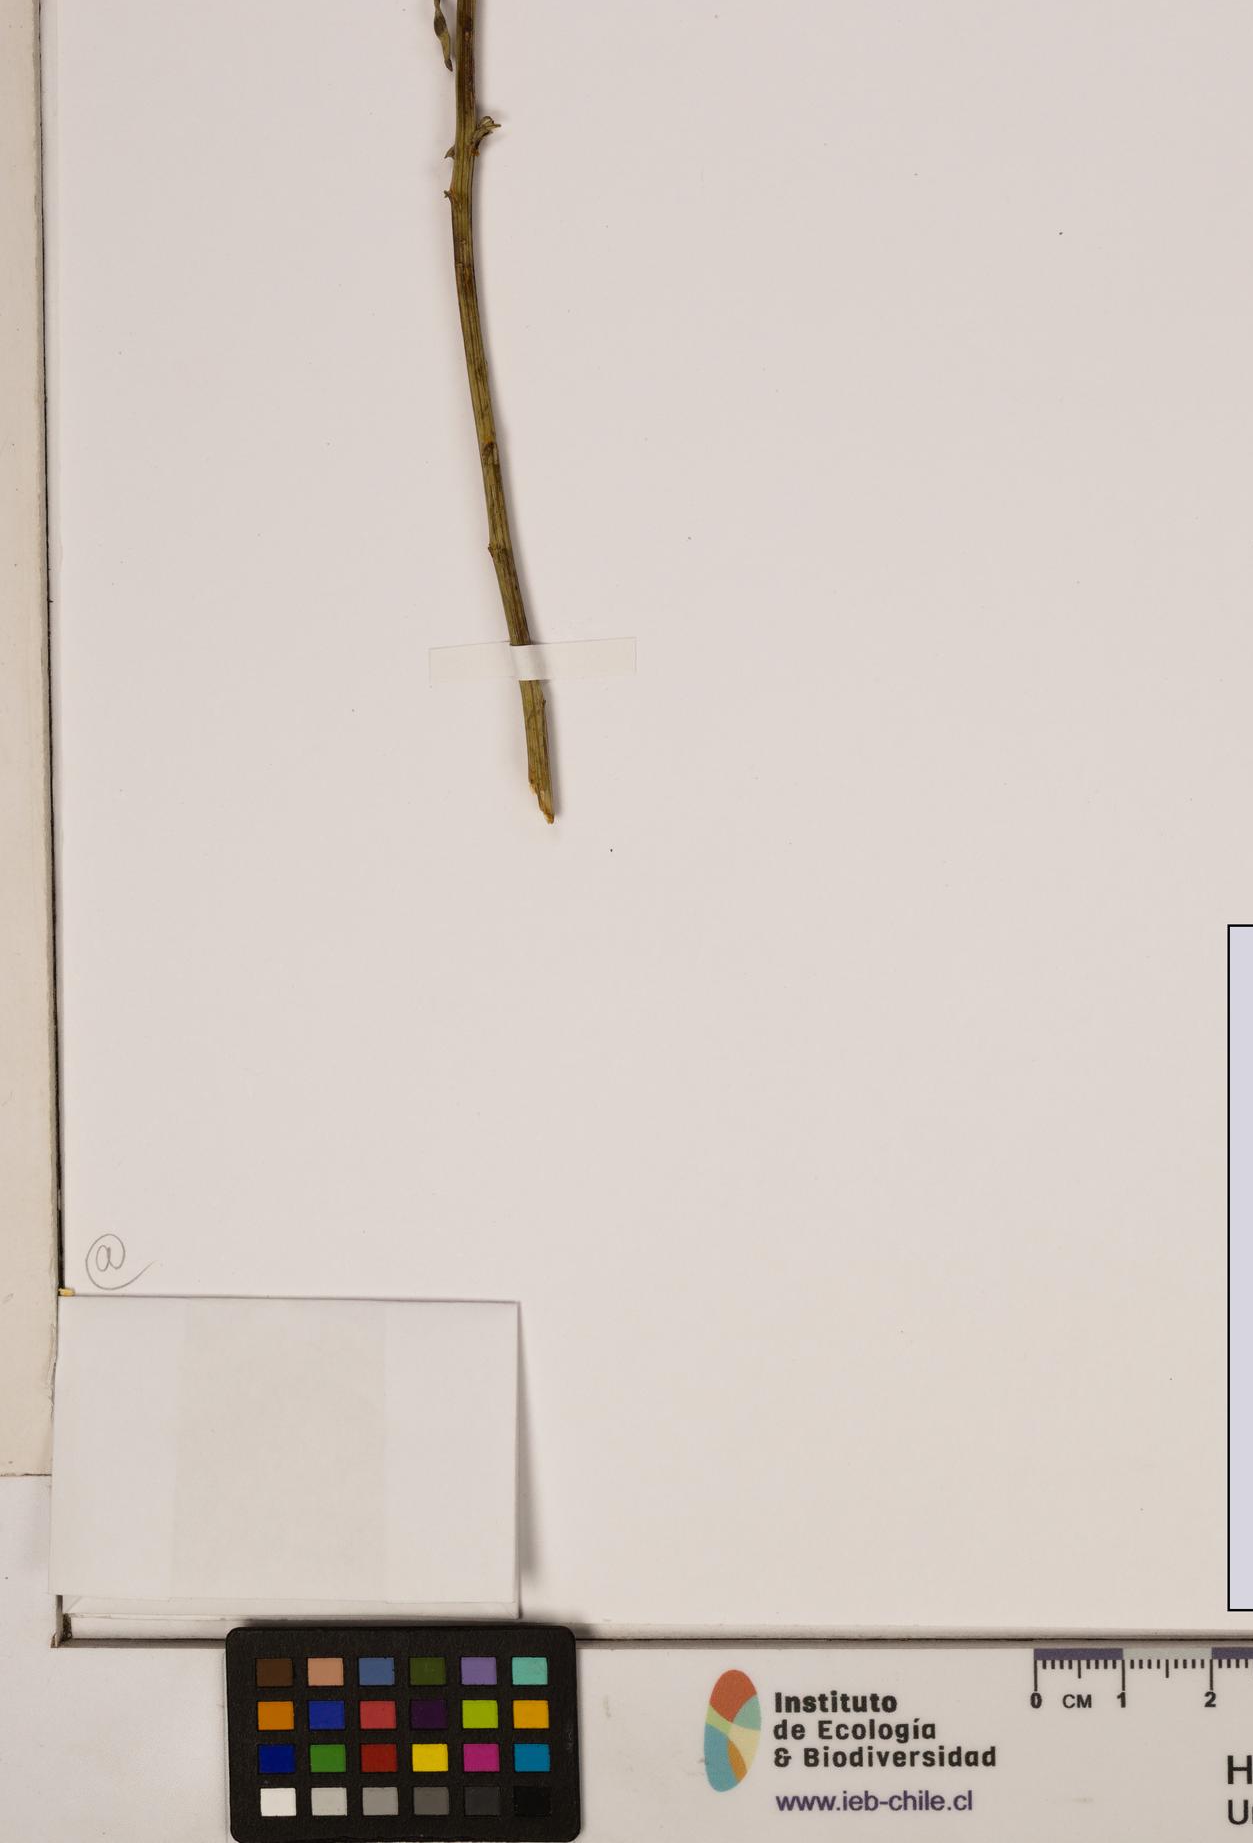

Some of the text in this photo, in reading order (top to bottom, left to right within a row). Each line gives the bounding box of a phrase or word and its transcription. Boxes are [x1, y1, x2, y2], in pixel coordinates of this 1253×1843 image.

[774, 1690, 899, 1714] Instituto
[1030, 1692, 1043, 1709] 0
[1062, 1694, 1093, 1709] CM
[1116, 1691, 1127, 1708] 1
[1204, 1691, 1217, 1708] 2
[772, 1718, 937, 1745] de Ecología
[773, 1744, 997, 1768] & Biodiversidad
[775, 1789, 973, 1812] www.ieb-chile.cl
